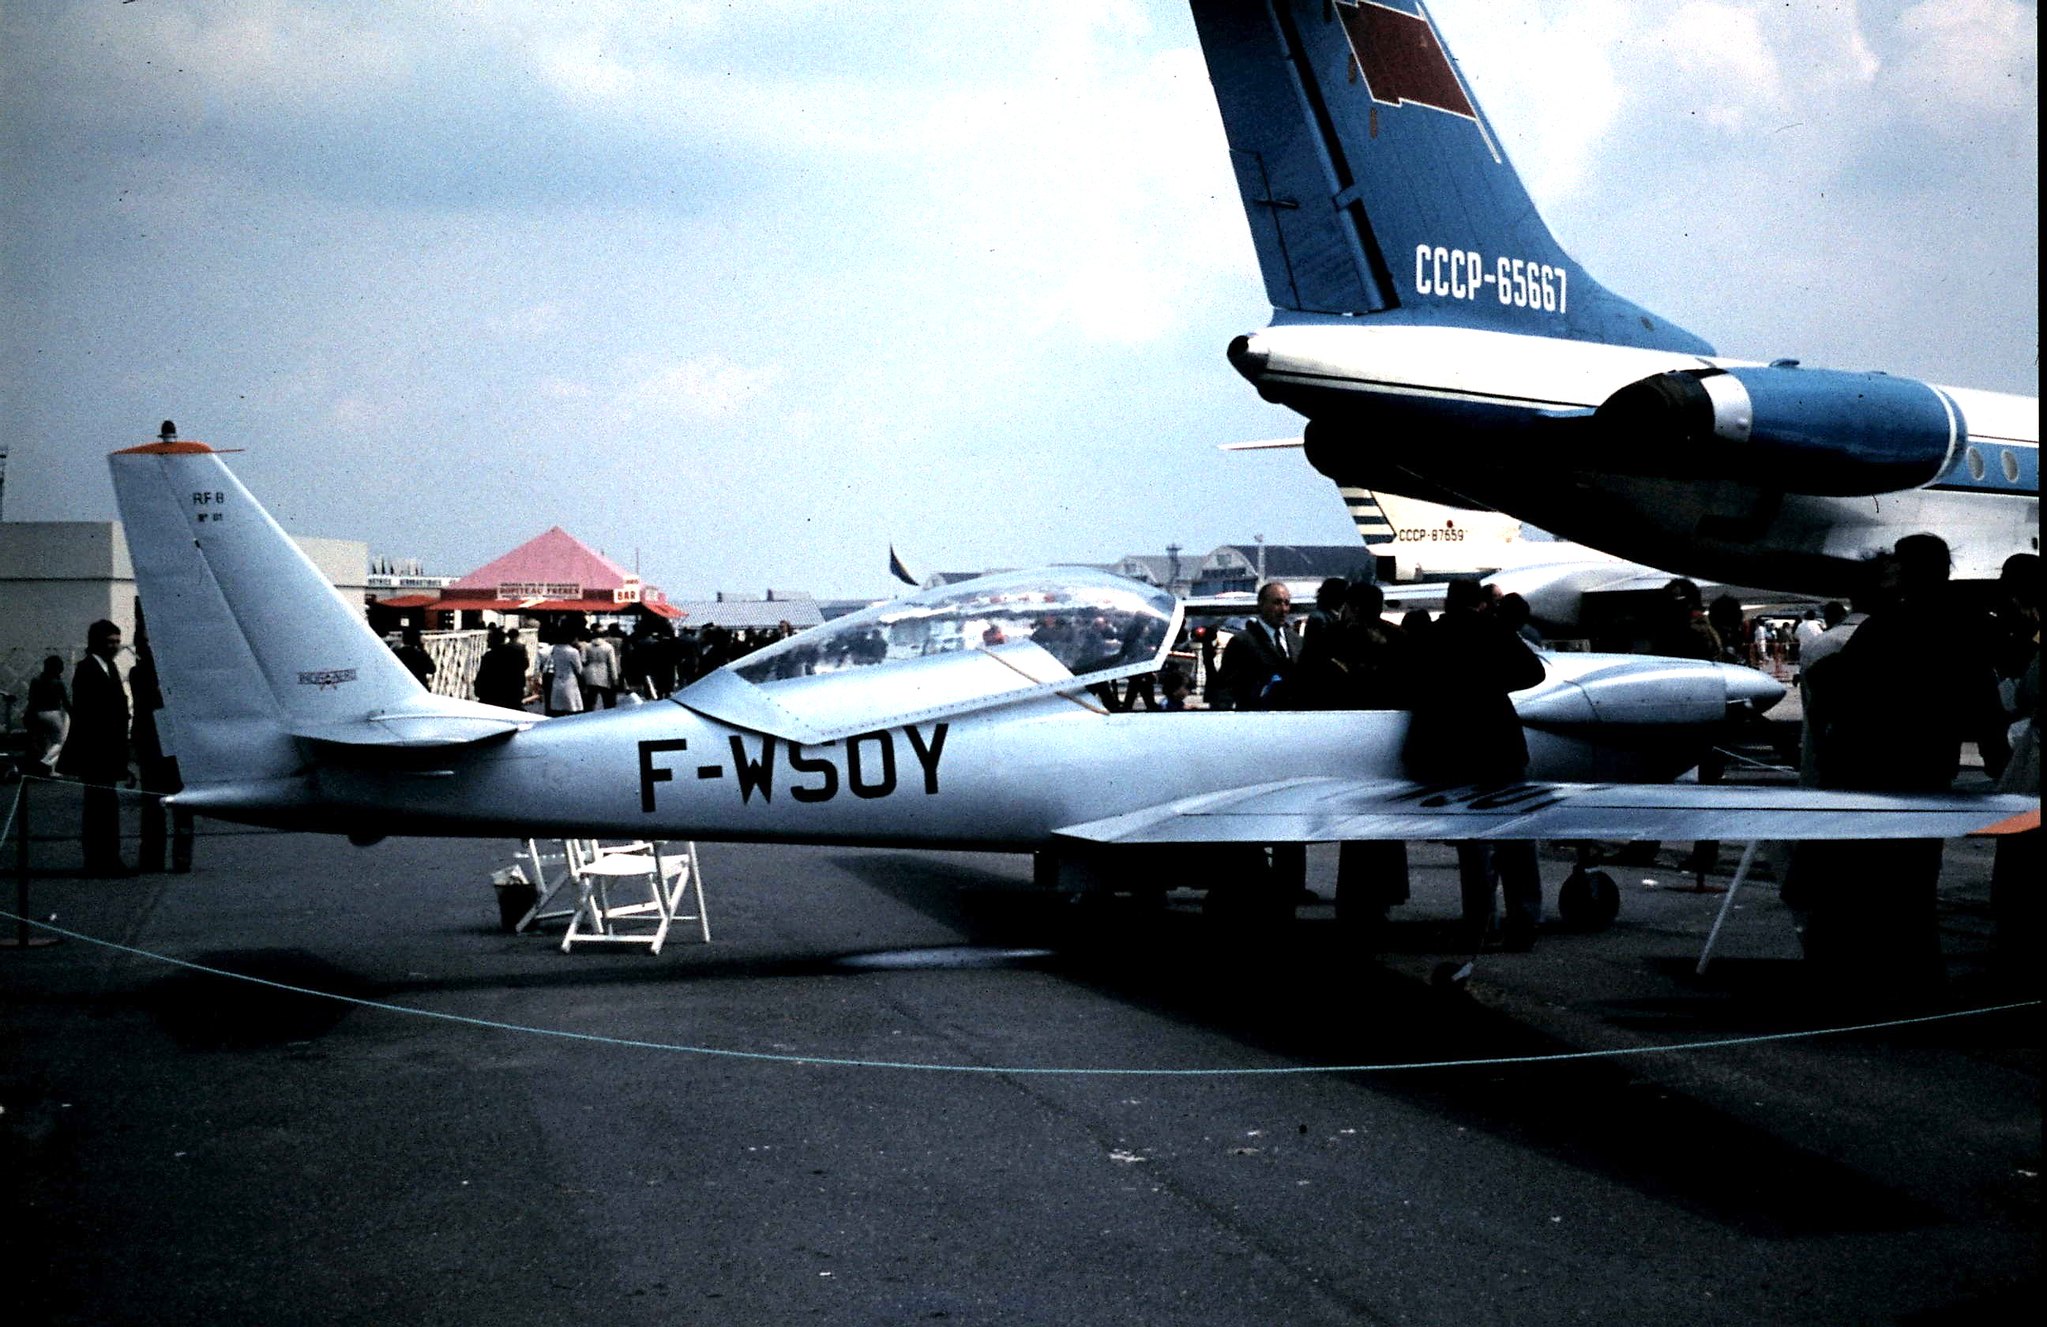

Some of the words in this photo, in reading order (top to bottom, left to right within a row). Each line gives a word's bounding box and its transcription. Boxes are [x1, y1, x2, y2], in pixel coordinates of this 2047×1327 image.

[1416, 244, 1567, 314] CCCP-65667
[193, 492, 211, 504] RF
[1399, 528, 1464, 542] CCCP-87659
[617, 590, 636, 601] BAR
[638, 723, 949, 813] F-WSOY
